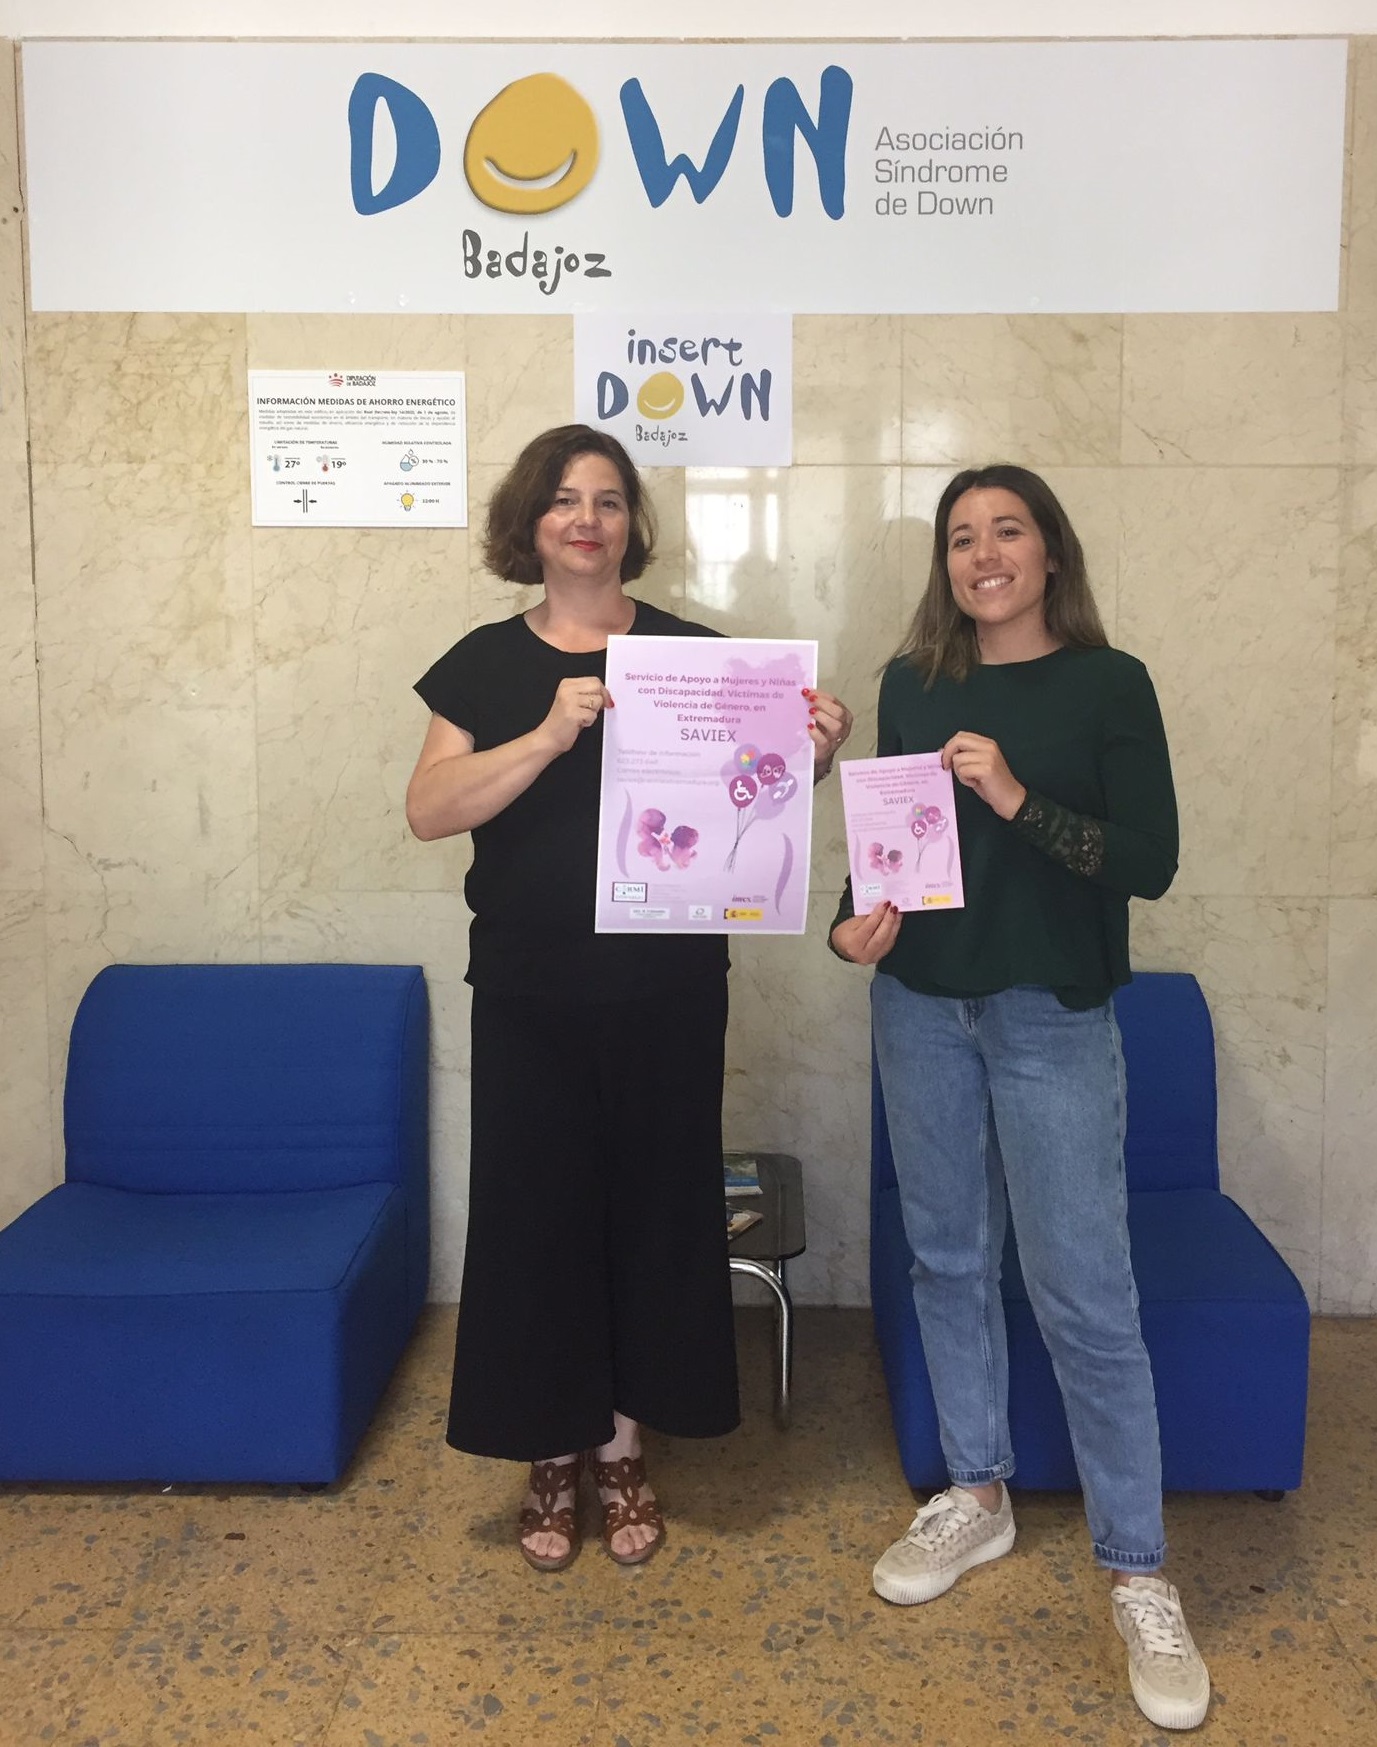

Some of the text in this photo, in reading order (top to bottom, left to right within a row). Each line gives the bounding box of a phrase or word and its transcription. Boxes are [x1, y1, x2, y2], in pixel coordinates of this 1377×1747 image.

[348, 65, 853, 220] DOWN
[875, 126, 1023, 150] Asociación
[875, 158, 1007, 183] Síndrome
[875, 191, 993, 215] de Down
[462, 229, 612, 295] Badajoz
[628, 329, 742, 366] insert
[256, 396, 316, 405] INFORMACIÓN
[369, 398, 404, 406] AHORRO
[406, 397, 456, 406] ENERGÉTICO
[597, 369, 771, 421] DOWN
[636, 424, 688, 447] Badajoz
[624, 673, 663, 682] Servicio
[665, 674, 677, 682] de
[680, 675, 711, 685] Apoyo
[721, 676, 758, 687] Mujeres
[759, 679, 765, 687] y
[769, 677, 796, 687] Niñas
[654, 699, 698, 709] Violencia
[700, 701, 712, 709] de
[772, 690, 784, 699] de
[677, 713, 741, 724] Extremadura
[680, 728, 737, 742] SAVIEX
[883, 796, 914, 806] SAVIEX
